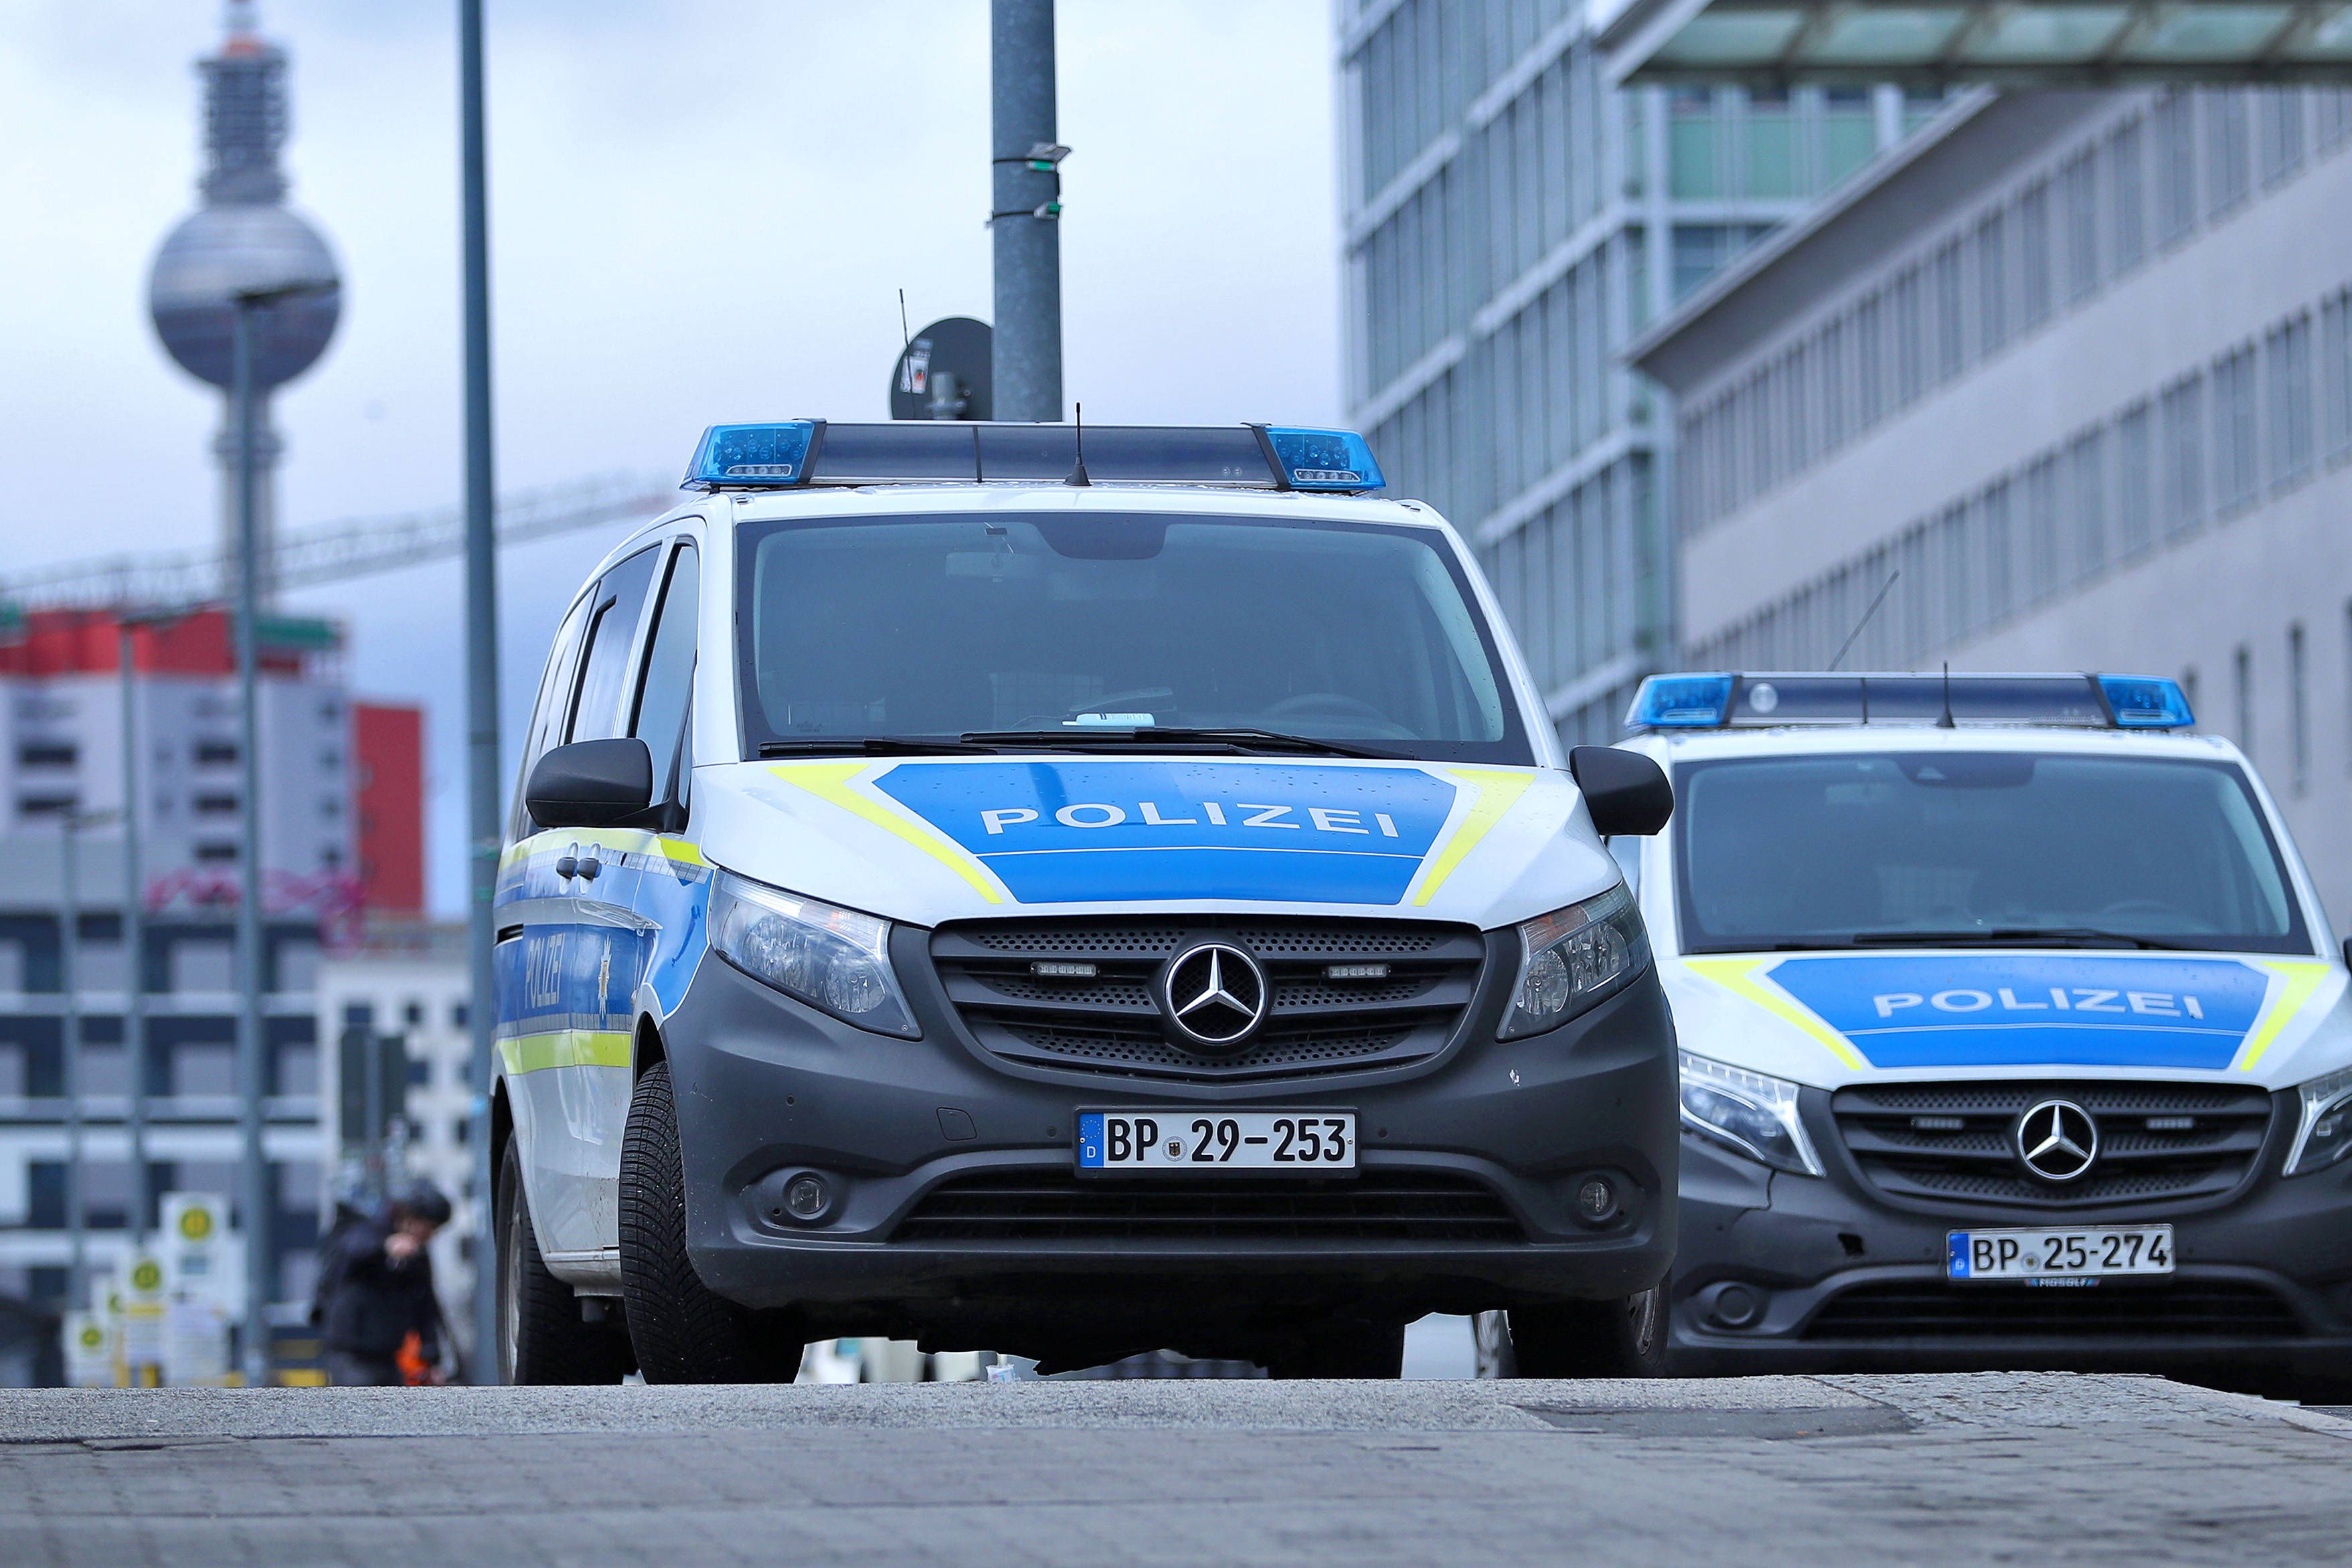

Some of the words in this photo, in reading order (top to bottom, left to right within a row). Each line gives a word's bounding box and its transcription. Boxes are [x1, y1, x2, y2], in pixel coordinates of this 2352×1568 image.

[980, 802, 1399, 838] POLIZEI
[525, 932, 566, 1009] POLIZEI
[1873, 988, 2203, 1020] POLIZEI
[1086, 1146, 1096, 1158] D
[1107, 1118, 1159, 1162] BP
[1191, 1118, 1346, 1162] 29-253
[1974, 1239, 2019, 1270] BP
[2043, 1235, 2167, 1270] 25-274
